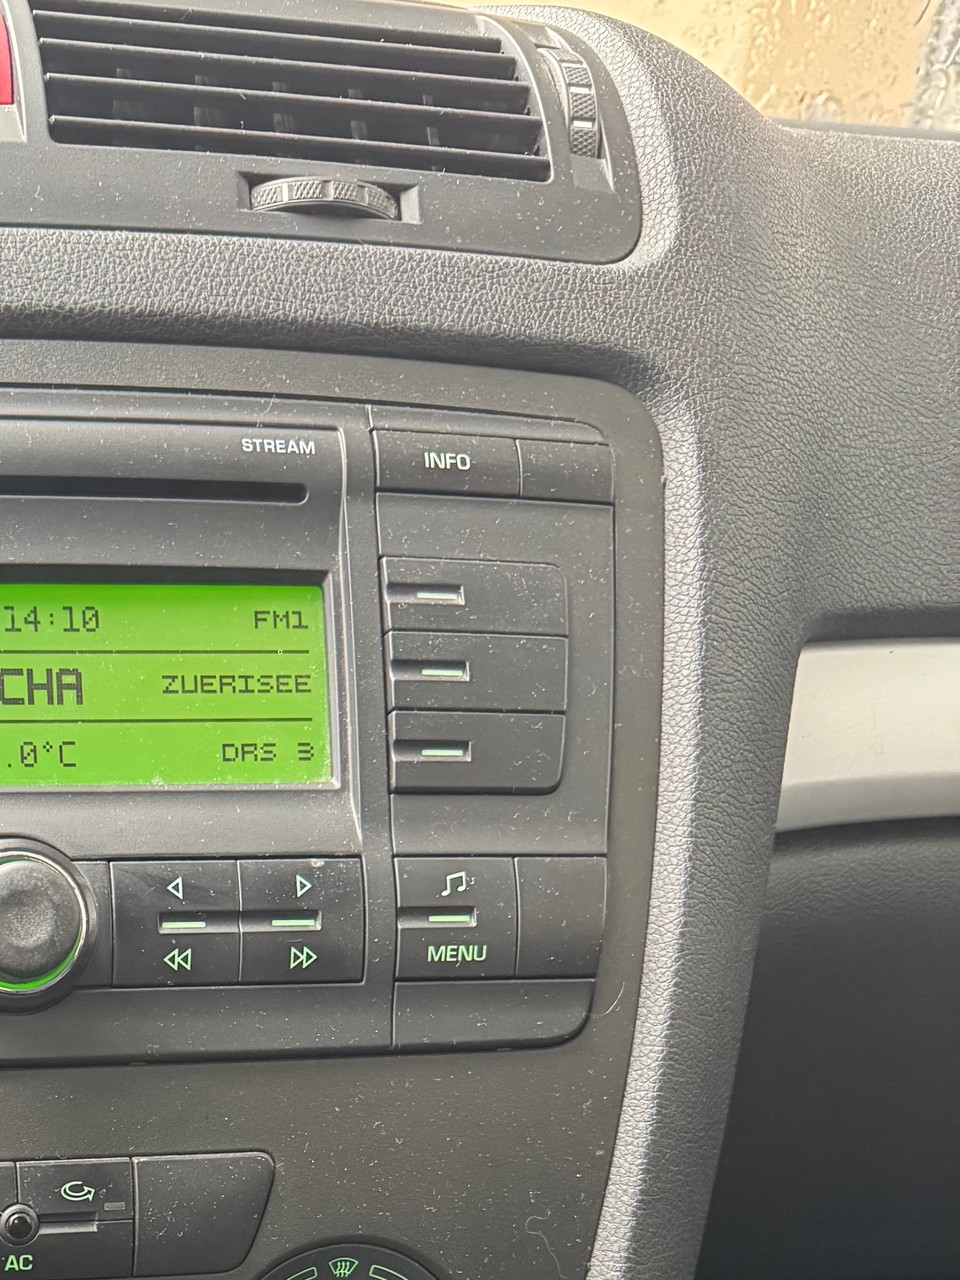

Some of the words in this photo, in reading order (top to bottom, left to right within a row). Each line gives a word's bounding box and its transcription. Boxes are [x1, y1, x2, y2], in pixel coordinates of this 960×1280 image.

[241, 438, 316, 456] STREAM
[424, 451, 471, 471] INFO
[4, 605, 100, 633] 14:10
[253, 610, 309, 629] FM1
[161, 674, 312, 694] ZUERISEE
[221, 742, 277, 763] DRS
[297, 742, 315, 762] 3
[427, 944, 487, 963] MENU
[4, 1254, 33, 1271] AC
